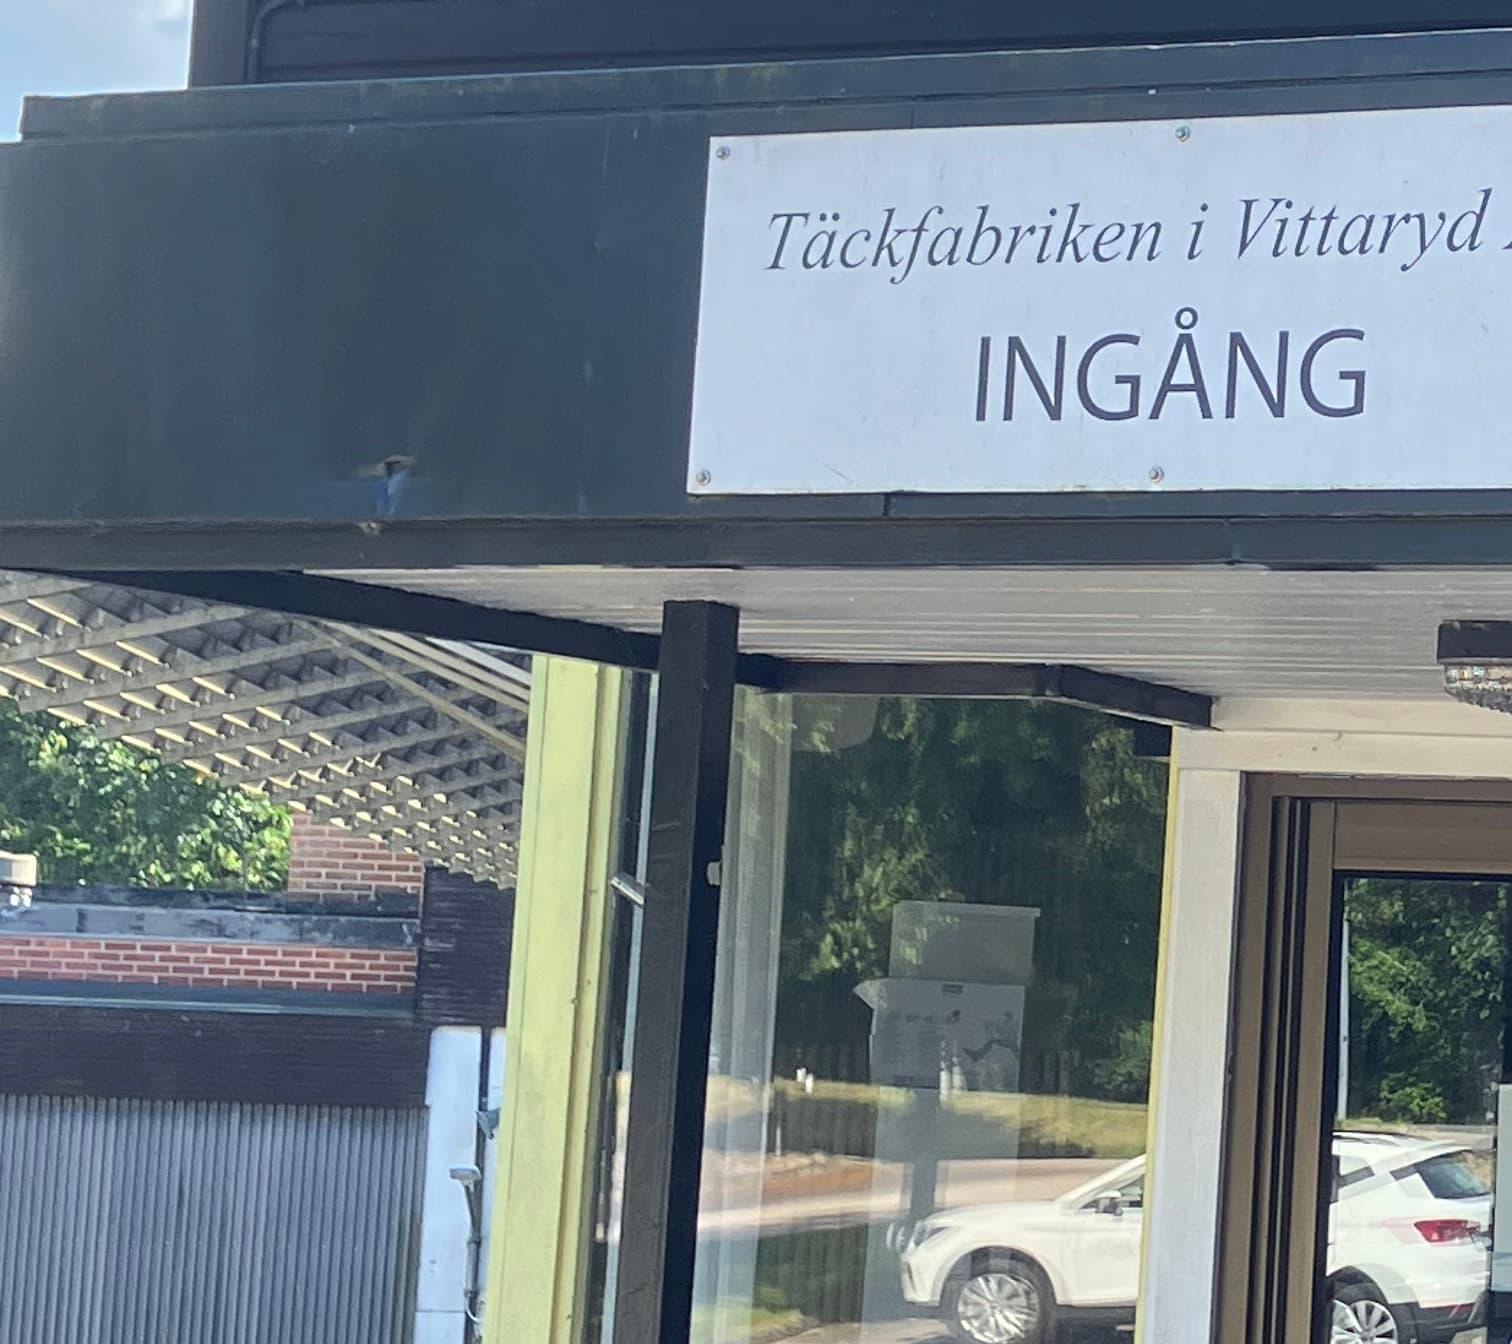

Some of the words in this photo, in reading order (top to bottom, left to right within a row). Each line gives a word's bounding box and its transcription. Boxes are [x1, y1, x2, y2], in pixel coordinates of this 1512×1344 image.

[763, 202, 1163, 283] Täckfabriken
[1186, 202, 1211, 261] i
[1234, 187, 1493, 277] Vittaryd
[974, 306, 1367, 422] INGÅNG
